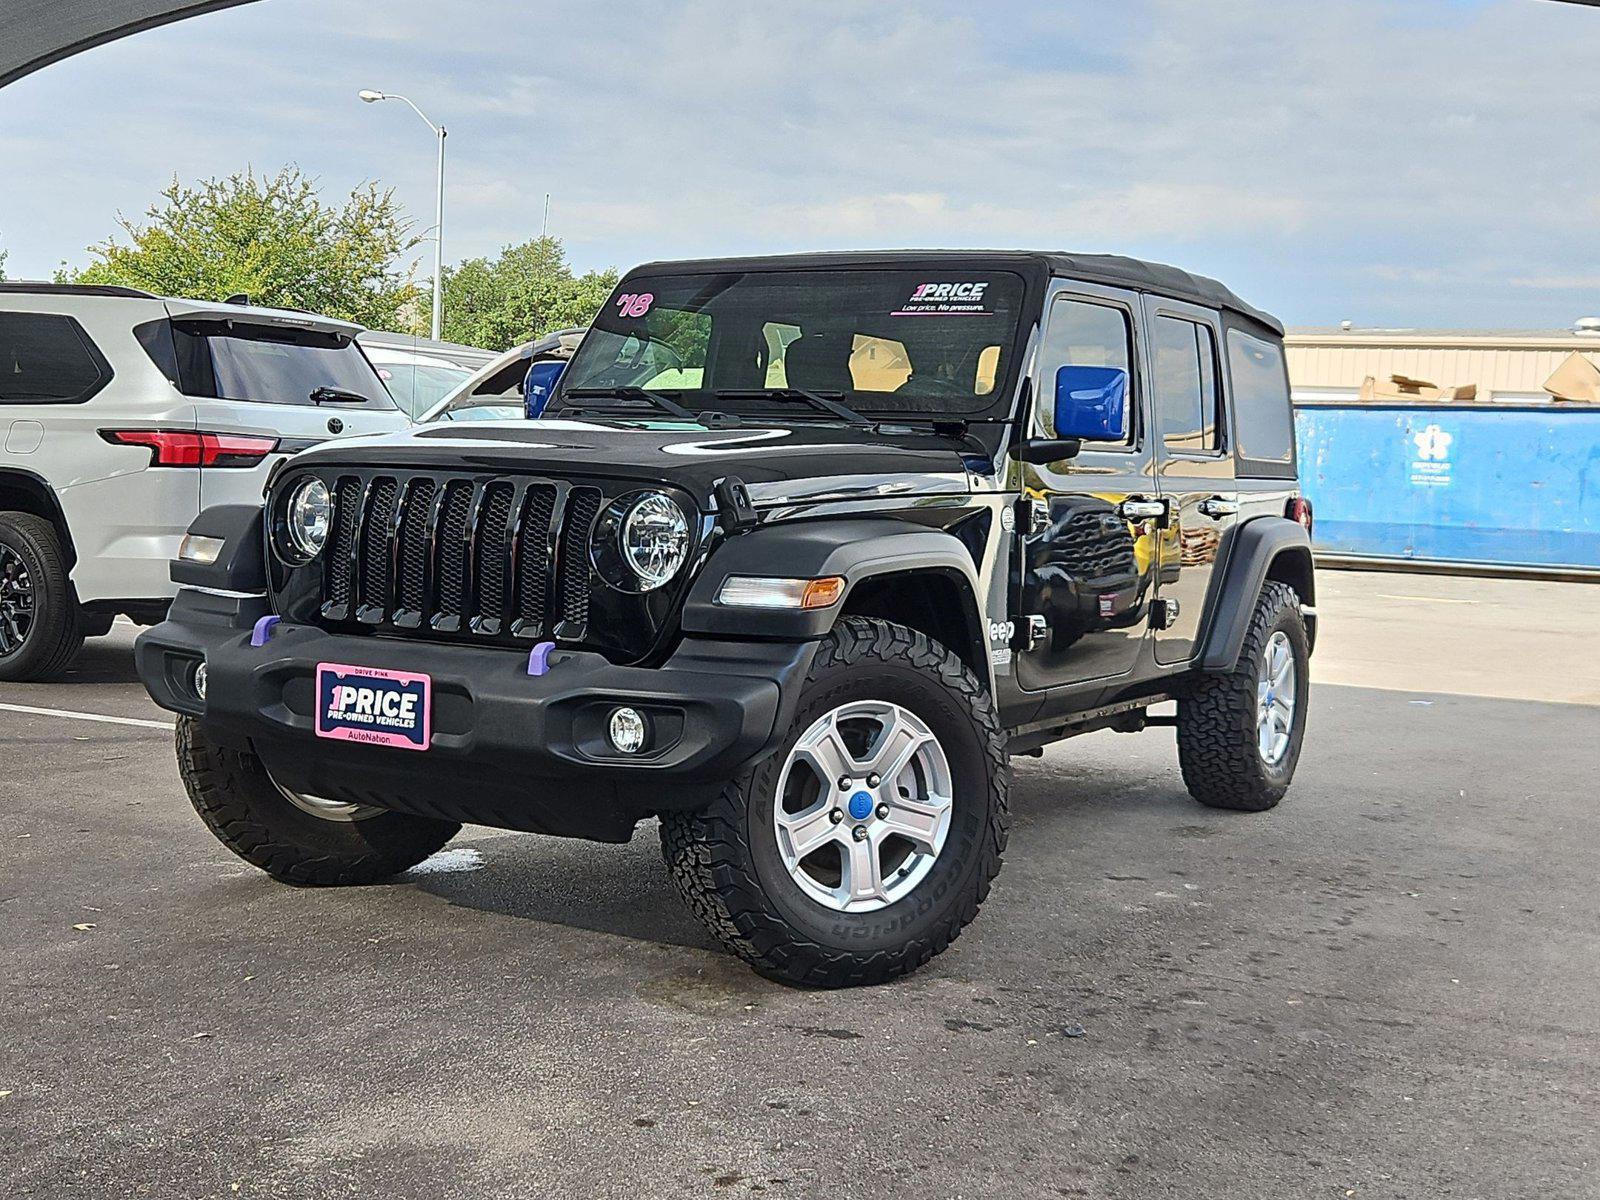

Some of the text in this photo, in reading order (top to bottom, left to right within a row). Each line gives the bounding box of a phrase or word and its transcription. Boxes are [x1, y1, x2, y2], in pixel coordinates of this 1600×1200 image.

[912, 282, 989, 297] 1PRICE
[902, 304, 917, 312] Low
[917, 304, 937, 312] price.
[949, 304, 984, 312] pressure.
[354, 668, 372, 676] DRIVE
[329, 685, 418, 719] 1PRICE
[327, 710, 415, 729] PRE-OWNED VEHICLES
[347, 731, 391, 744] AutoNation
